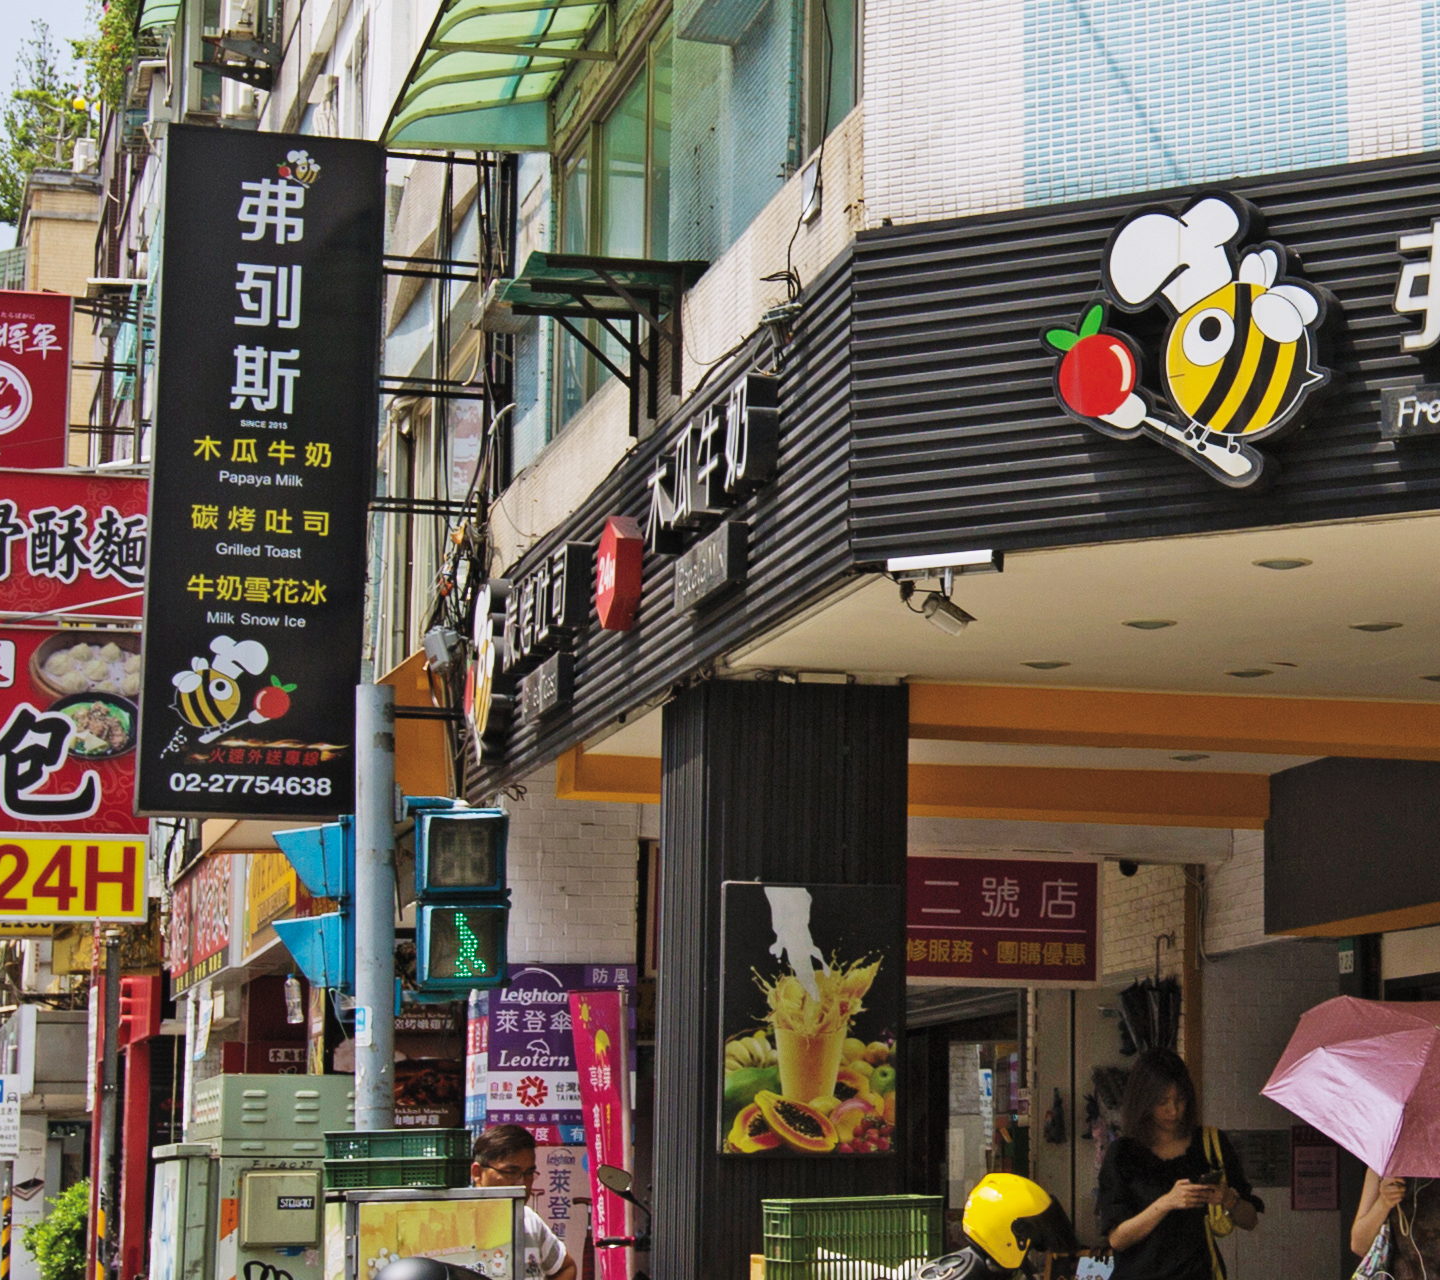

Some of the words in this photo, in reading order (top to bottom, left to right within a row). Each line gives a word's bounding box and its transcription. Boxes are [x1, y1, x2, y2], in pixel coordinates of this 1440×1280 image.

[231, 179, 307, 415] 弗列斯
[240, 419, 266, 429] SINCE
[268, 421, 288, 429] 2015
[194, 435, 332, 468] 木瓜牛奶
[219, 470, 271, 487] Papaya
[275, 473, 303, 487] Milk
[191, 504, 329, 536] 碳烤吐司
[216, 542, 260, 556] Grilled
[264, 545, 302, 559] Toast
[598, 552, 616, 596] 24H
[187, 574, 327, 605] 牛奶雪花冰
[206, 611, 235, 624] Milk
[240, 613, 279, 626] Snow
[284, 615, 306, 627] Ice
[209, 748, 320, 766] 火速外送專線
[169, 772, 332, 796] 02-27754638
[921, 876, 1078, 919] 二號店
[593, 968, 630, 984] 防風
[500, 987, 569, 1005] Leighton
[495, 1009, 573, 1034] 萊登傘
[498, 1050, 570, 1068] Leotern
[490, 1081, 513, 1092] 自動
[546, 1153, 576, 1166] Leighton
